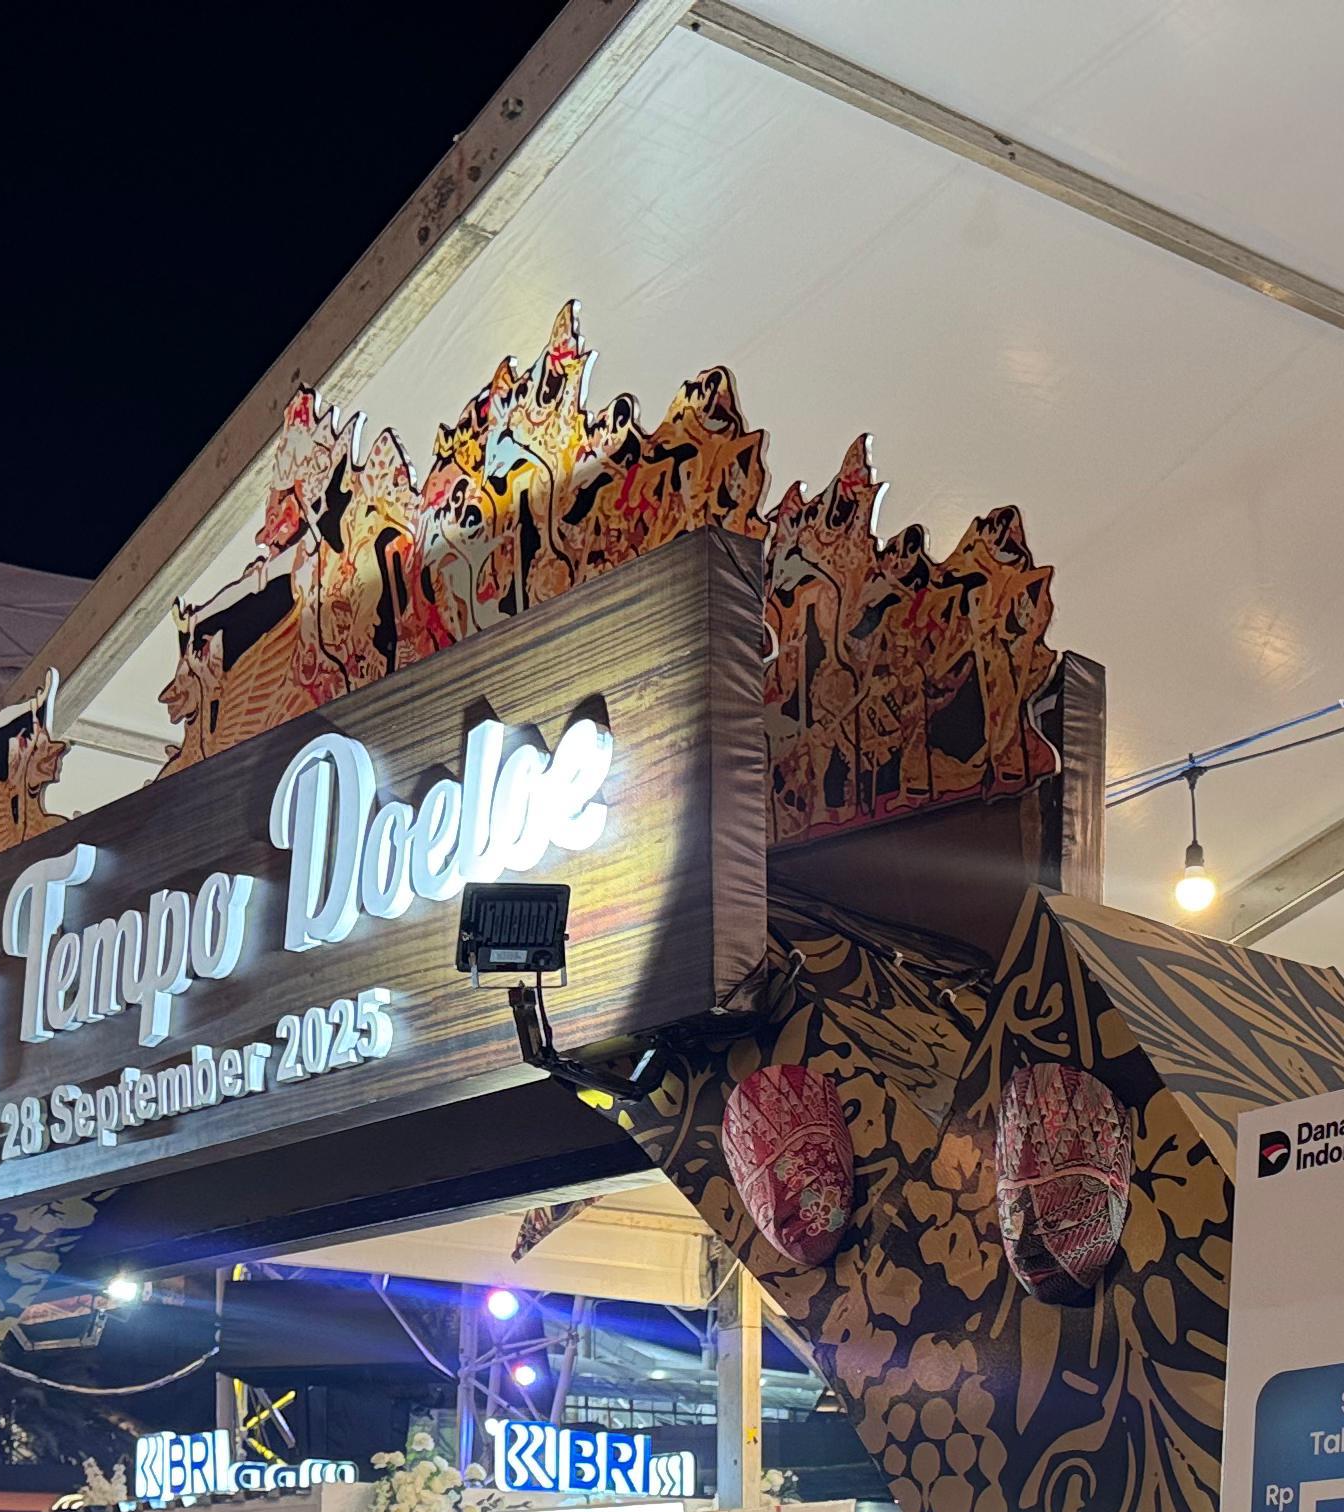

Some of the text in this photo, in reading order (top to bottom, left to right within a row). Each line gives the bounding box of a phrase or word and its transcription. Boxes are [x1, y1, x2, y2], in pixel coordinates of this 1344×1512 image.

[2, 843, 254, 1047] Tempo
[269, 718, 614, 952] Doeloe
[1, 1097, 49, 1160] 28
[51, 1042, 271, 1147] September
[276, 988, 394, 1083] 2025
[1266, 1484, 1294, 1512] Rp
